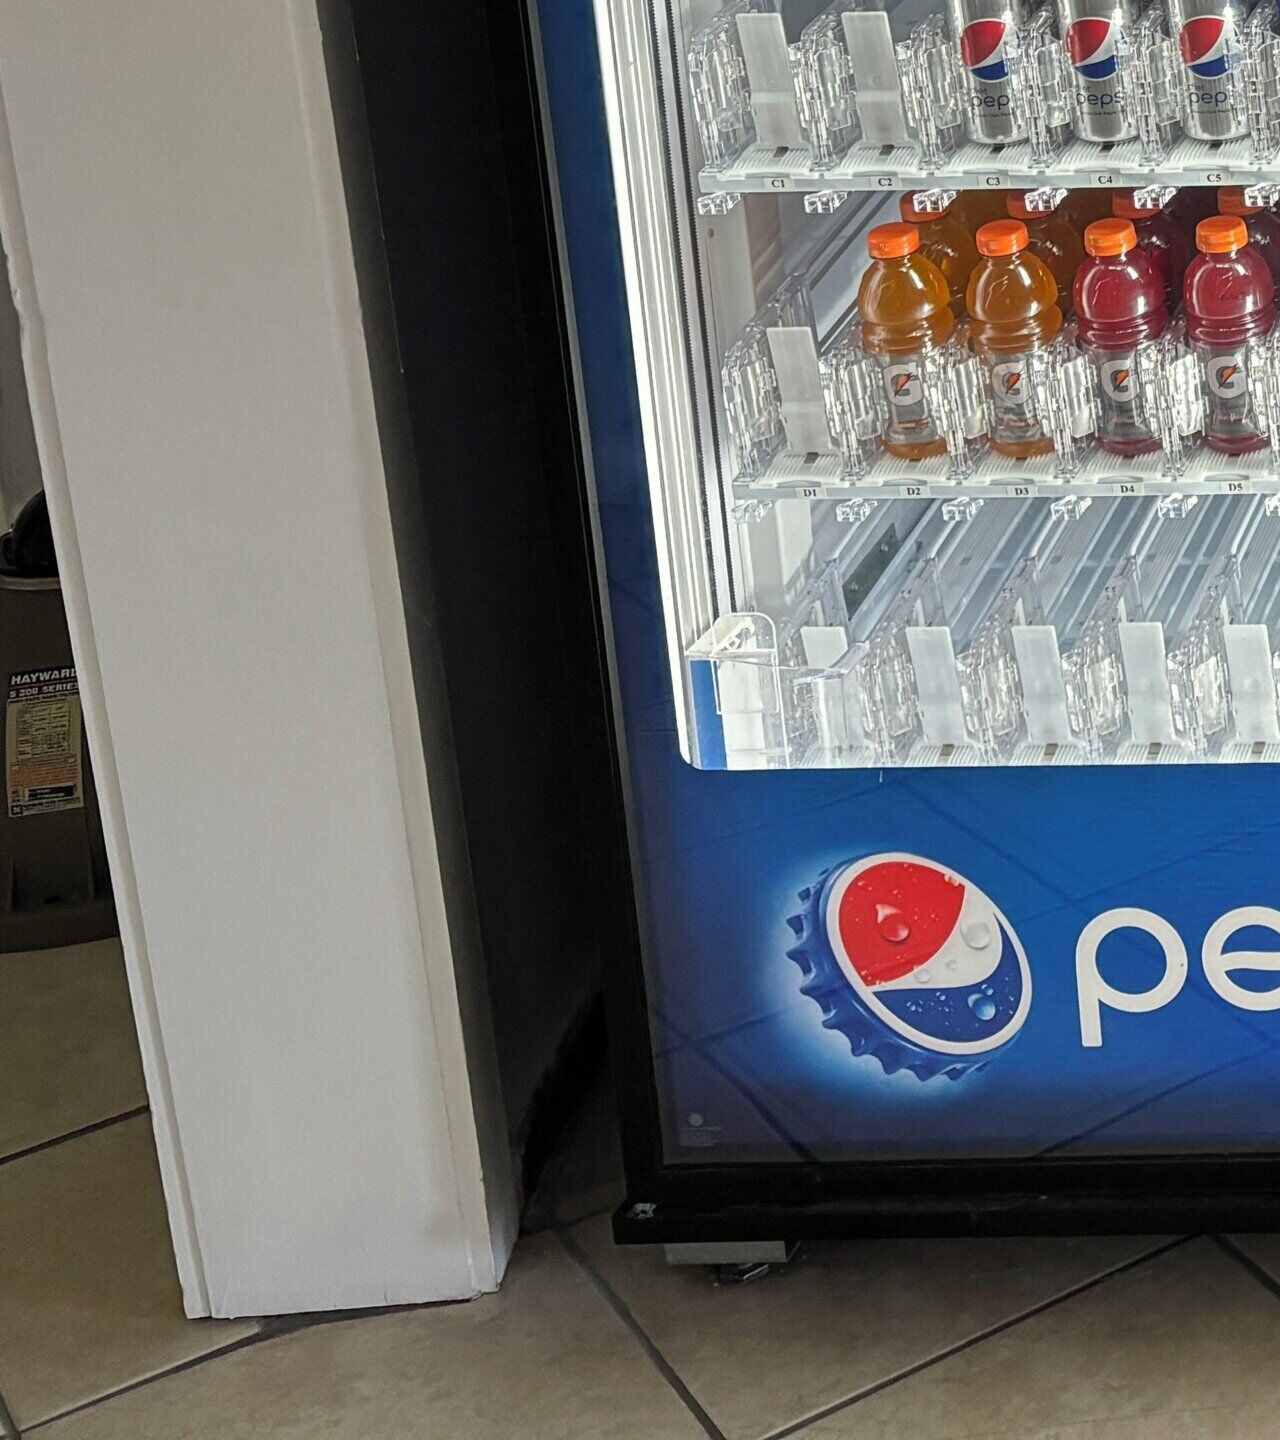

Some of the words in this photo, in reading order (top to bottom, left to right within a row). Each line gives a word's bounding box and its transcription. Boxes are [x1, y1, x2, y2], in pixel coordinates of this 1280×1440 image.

[878, 177, 892, 187] C2
[986, 176, 1000, 185] C3
[1207, 173, 1221, 182] C5
[804, 489, 817, 497] D1
[907, 487, 921, 495] D2
